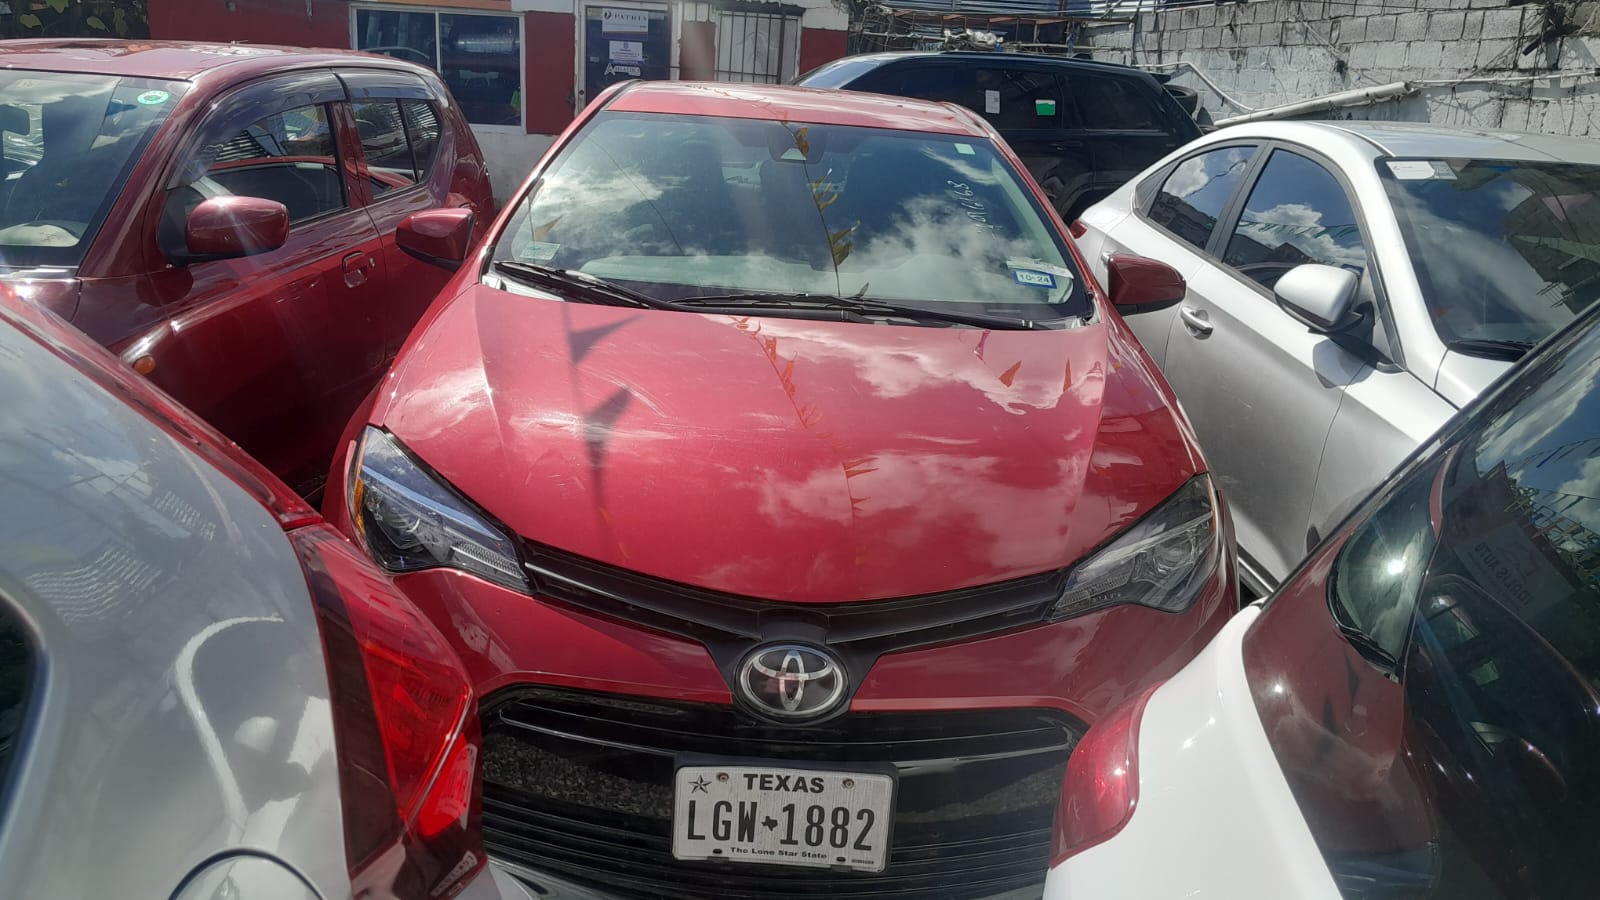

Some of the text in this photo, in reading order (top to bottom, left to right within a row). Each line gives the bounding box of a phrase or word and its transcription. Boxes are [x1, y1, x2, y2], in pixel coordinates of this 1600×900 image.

[614, 12, 647, 21] PATRIA
[743, 773, 825, 794] TEXAS
[687, 800, 875, 851] LGW 1882
[751, 847, 775, 856] Lone
[778, 849, 799, 857] Star
[801, 851, 827, 859] State
